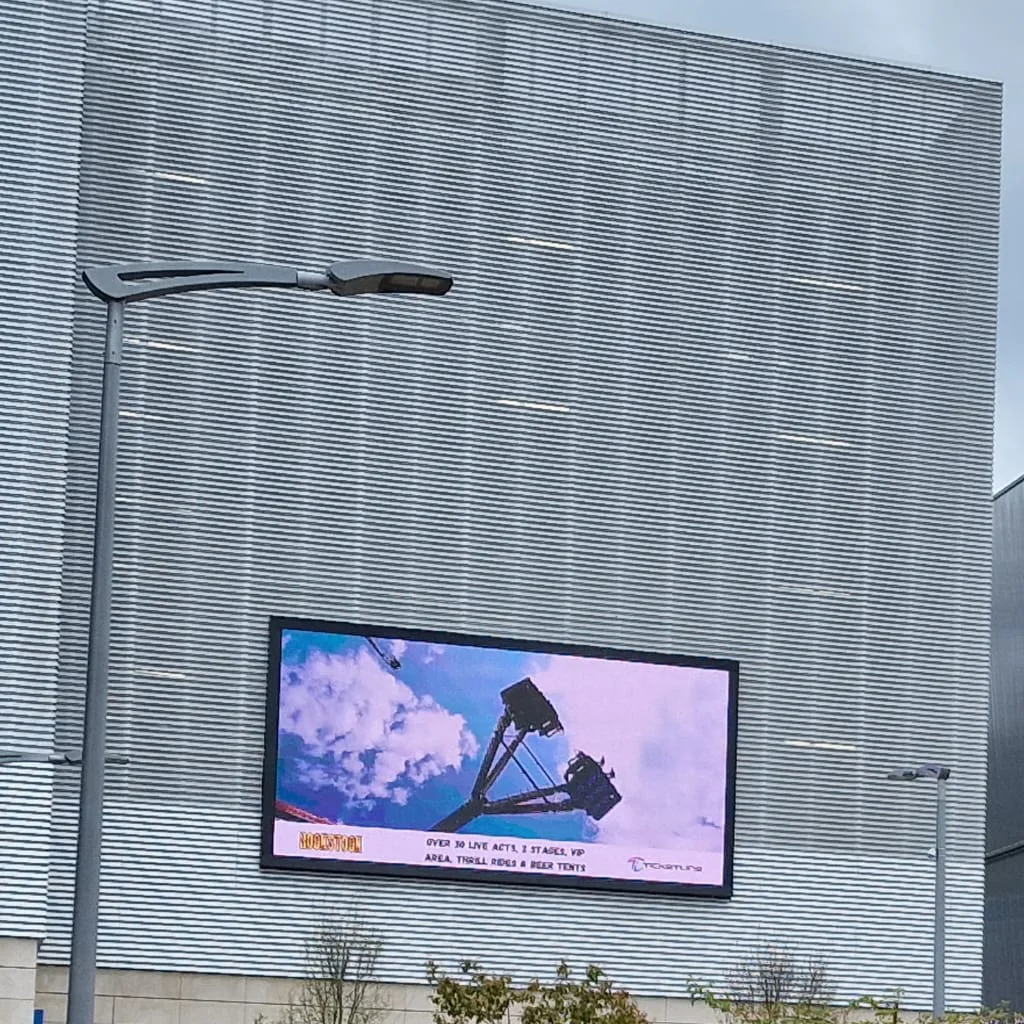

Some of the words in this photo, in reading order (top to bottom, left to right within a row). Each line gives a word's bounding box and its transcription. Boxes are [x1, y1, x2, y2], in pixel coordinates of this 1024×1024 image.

[426, 838, 451, 848] OVER
[468, 841, 489, 851] LIVE
[530, 861, 554, 870] BEER
[557, 862, 587, 873] TENTS
